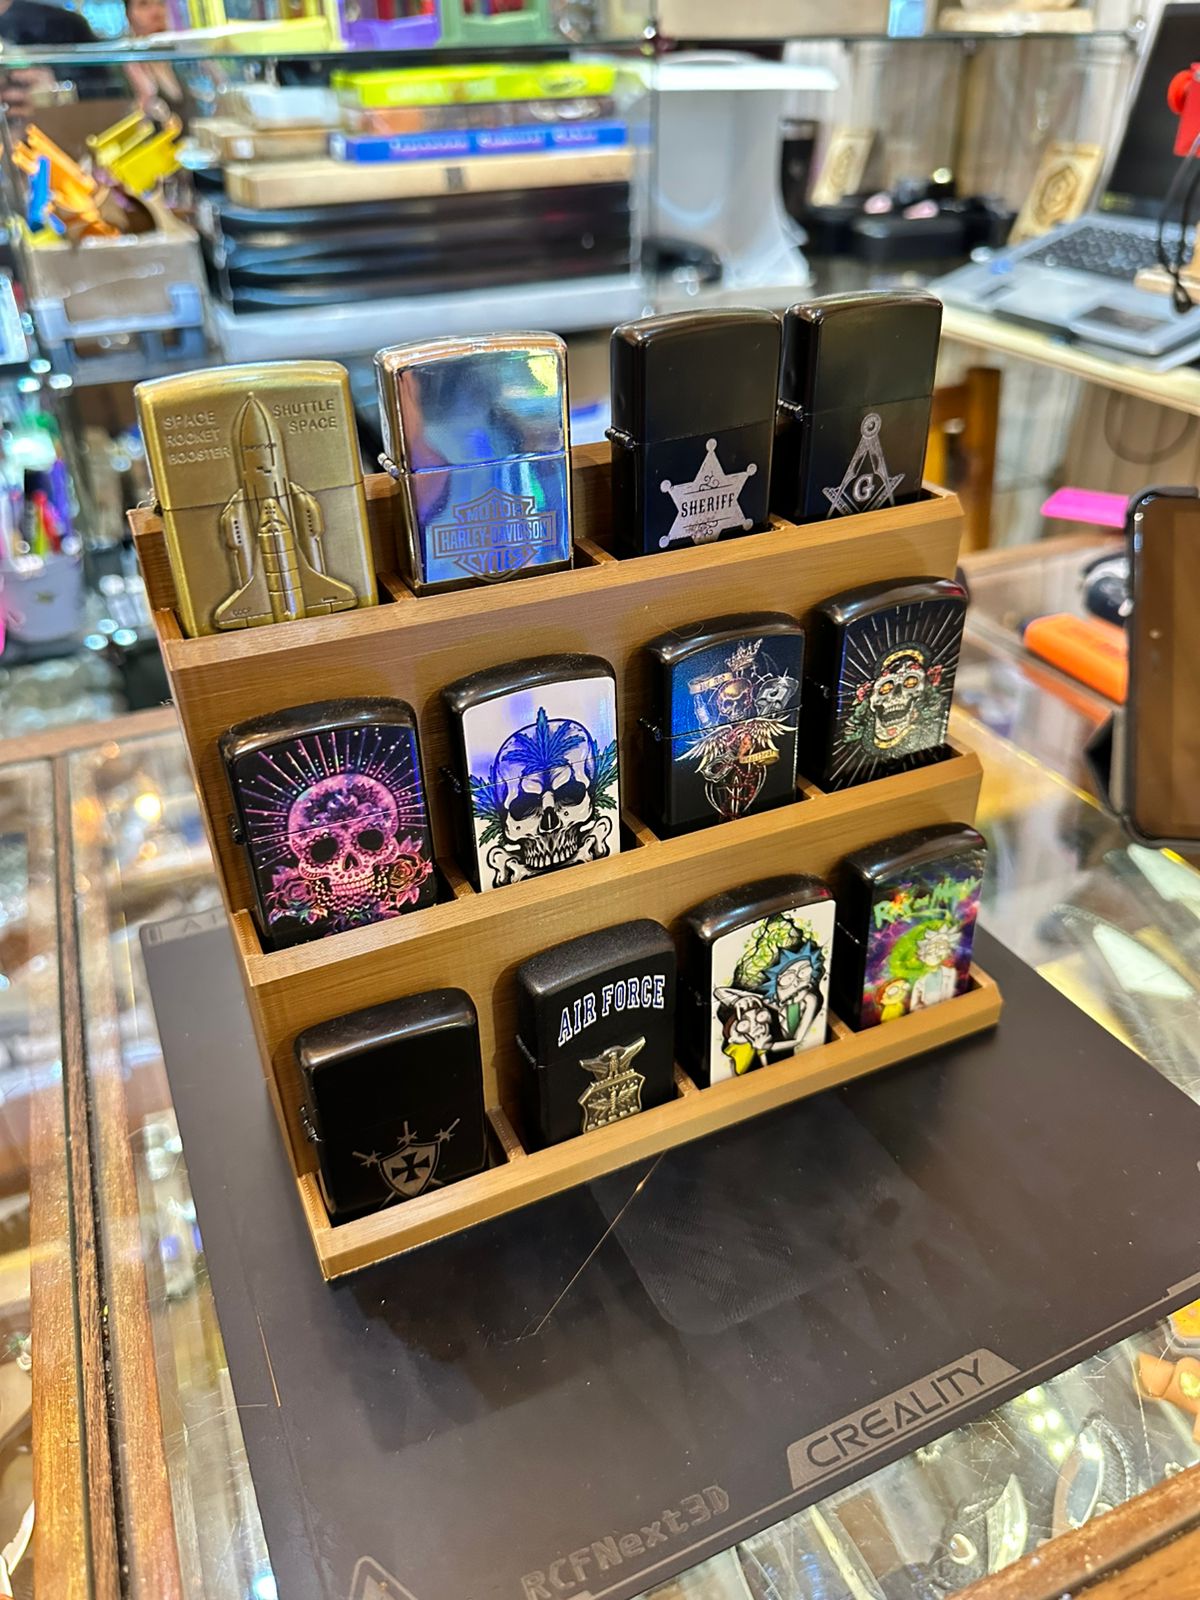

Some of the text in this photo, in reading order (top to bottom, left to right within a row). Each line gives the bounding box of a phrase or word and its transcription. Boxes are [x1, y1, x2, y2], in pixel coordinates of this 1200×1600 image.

[164, 411, 217, 430] SPACE
[273, 399, 336, 418] SHUTTLE
[288, 416, 338, 435] SPACE
[165, 429, 221, 448] ROCKET
[168, 447, 232, 466] BOOSTER
[852, 473, 875, 502] G
[466, 498, 524, 523] MOTOR
[681, 492, 735, 518] SHERIFF
[557, 974, 666, 1048] AIR FORCE
[806, 1357, 986, 1468] CREALITY
[520, 1484, 731, 1600] RCFNext3D
